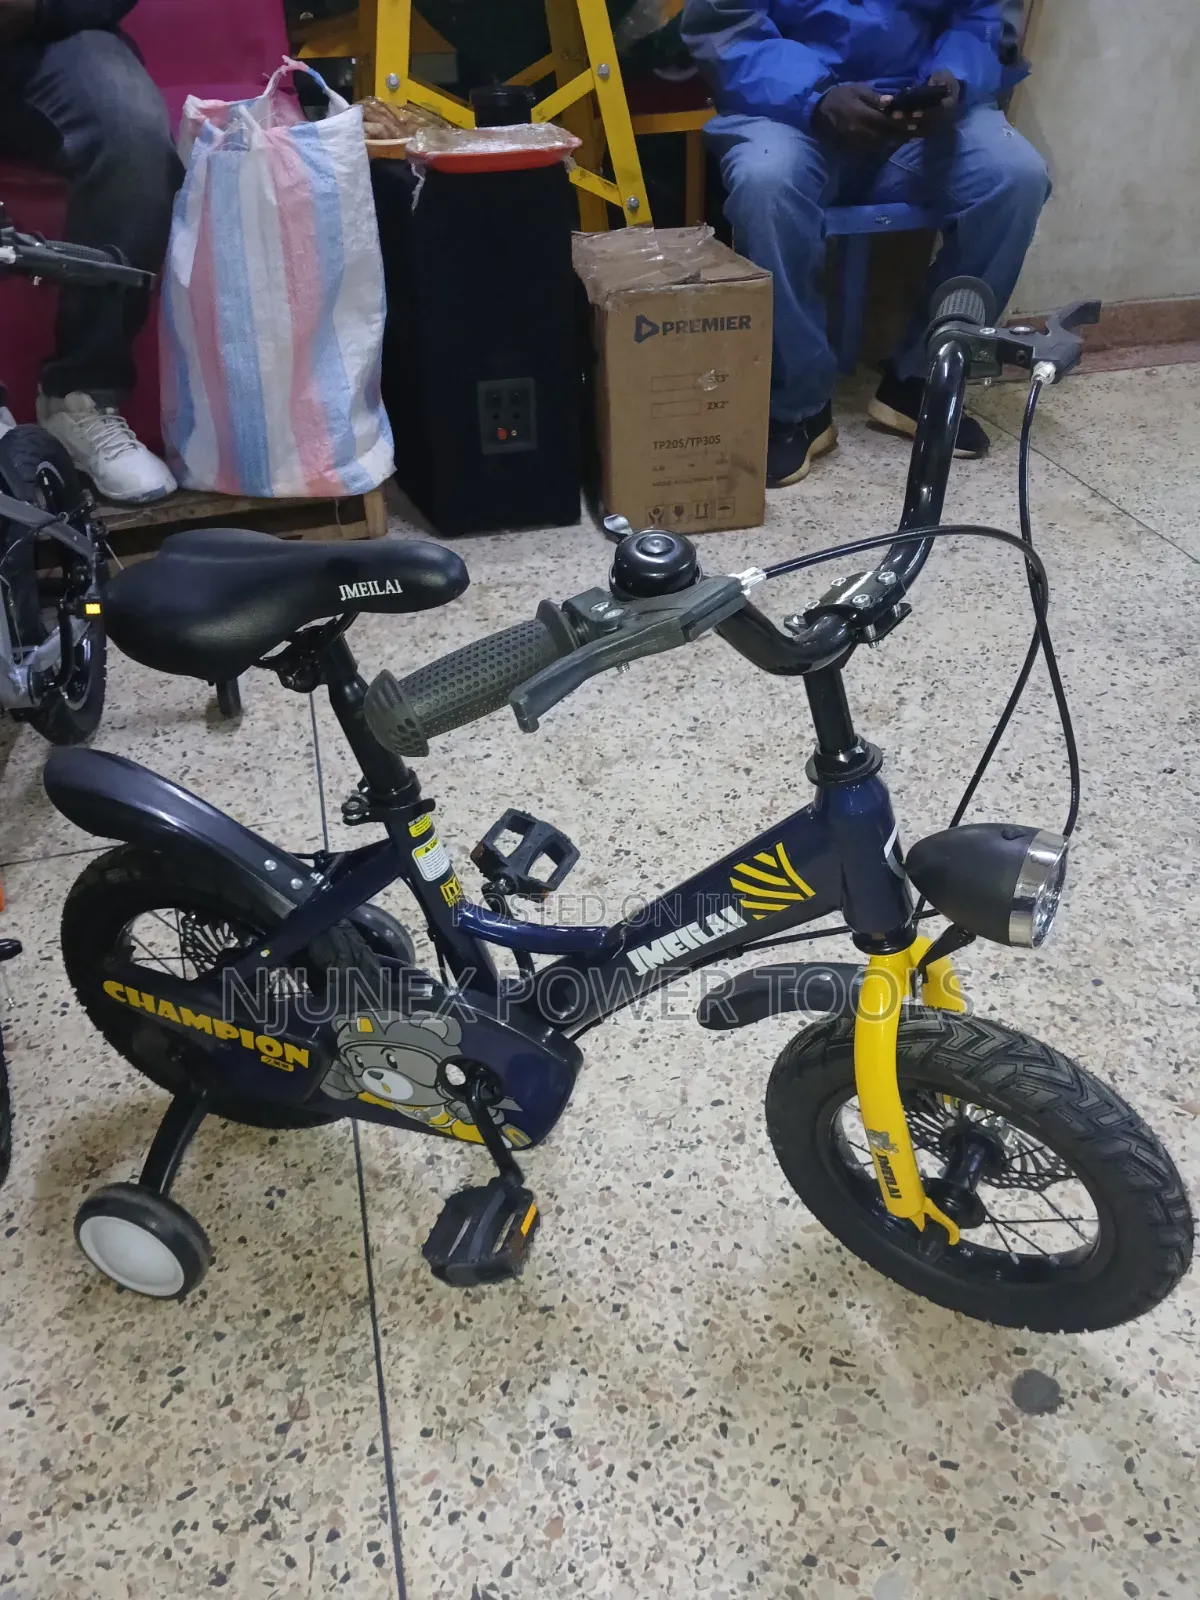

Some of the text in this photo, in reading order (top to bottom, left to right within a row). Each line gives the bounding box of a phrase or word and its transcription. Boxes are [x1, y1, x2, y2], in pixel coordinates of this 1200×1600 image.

[661, 314, 752, 336] PREMIER
[652, 434, 721, 451] TP20S/TP30S
[338, 578, 403, 602] JMEILAI
[626, 905, 748, 977] JMEILAI
[102, 979, 310, 1069] CHAMPION
